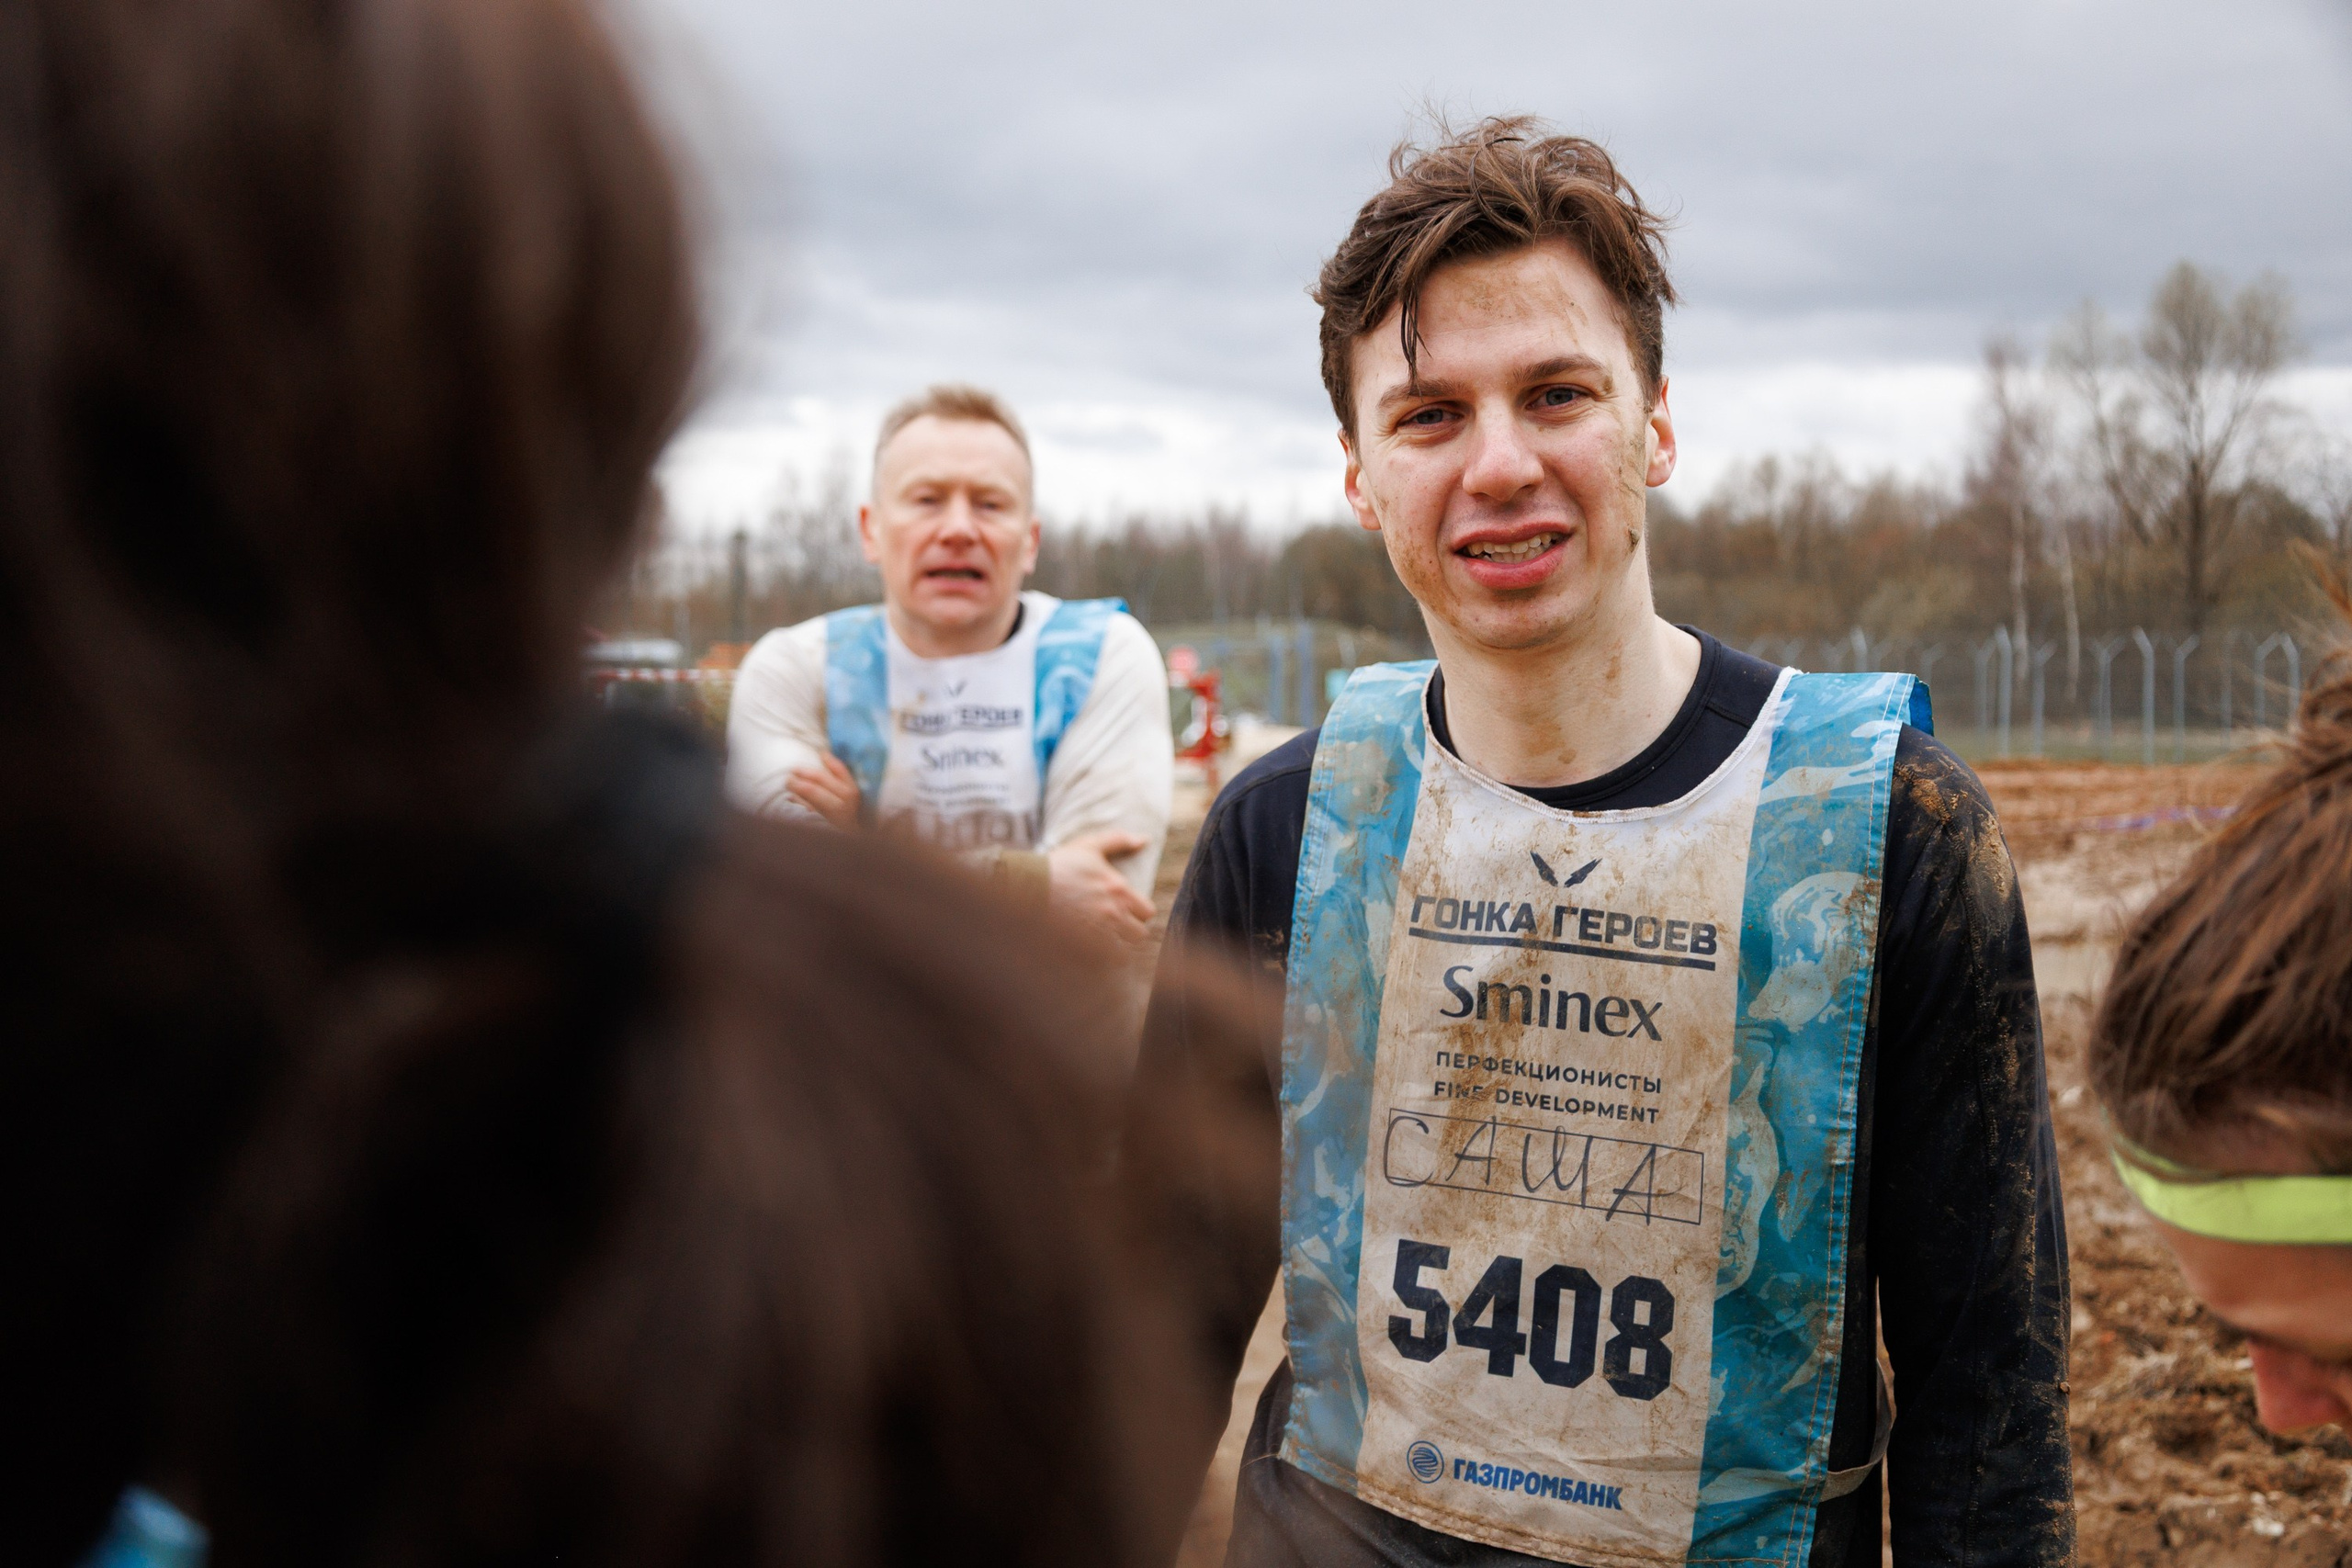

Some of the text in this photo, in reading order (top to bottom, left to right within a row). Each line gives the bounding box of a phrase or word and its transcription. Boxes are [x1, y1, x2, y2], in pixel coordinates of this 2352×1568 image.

[1409, 896, 1718, 955] ГОНКА ГЕРОЕВ
[1440, 964, 1663, 1042] Sminex
[1435, 1051, 1662, 1094] ПЕРФЕКЦИОНИСТЫ
[1495, 1089, 1660, 1123] DEVELOPMENT
[1383, 1115, 1678, 1226] САША
[1388, 1238, 1676, 1402] 5408
[1453, 1459, 1623, 1510] ГАЗПРОМБАНК
